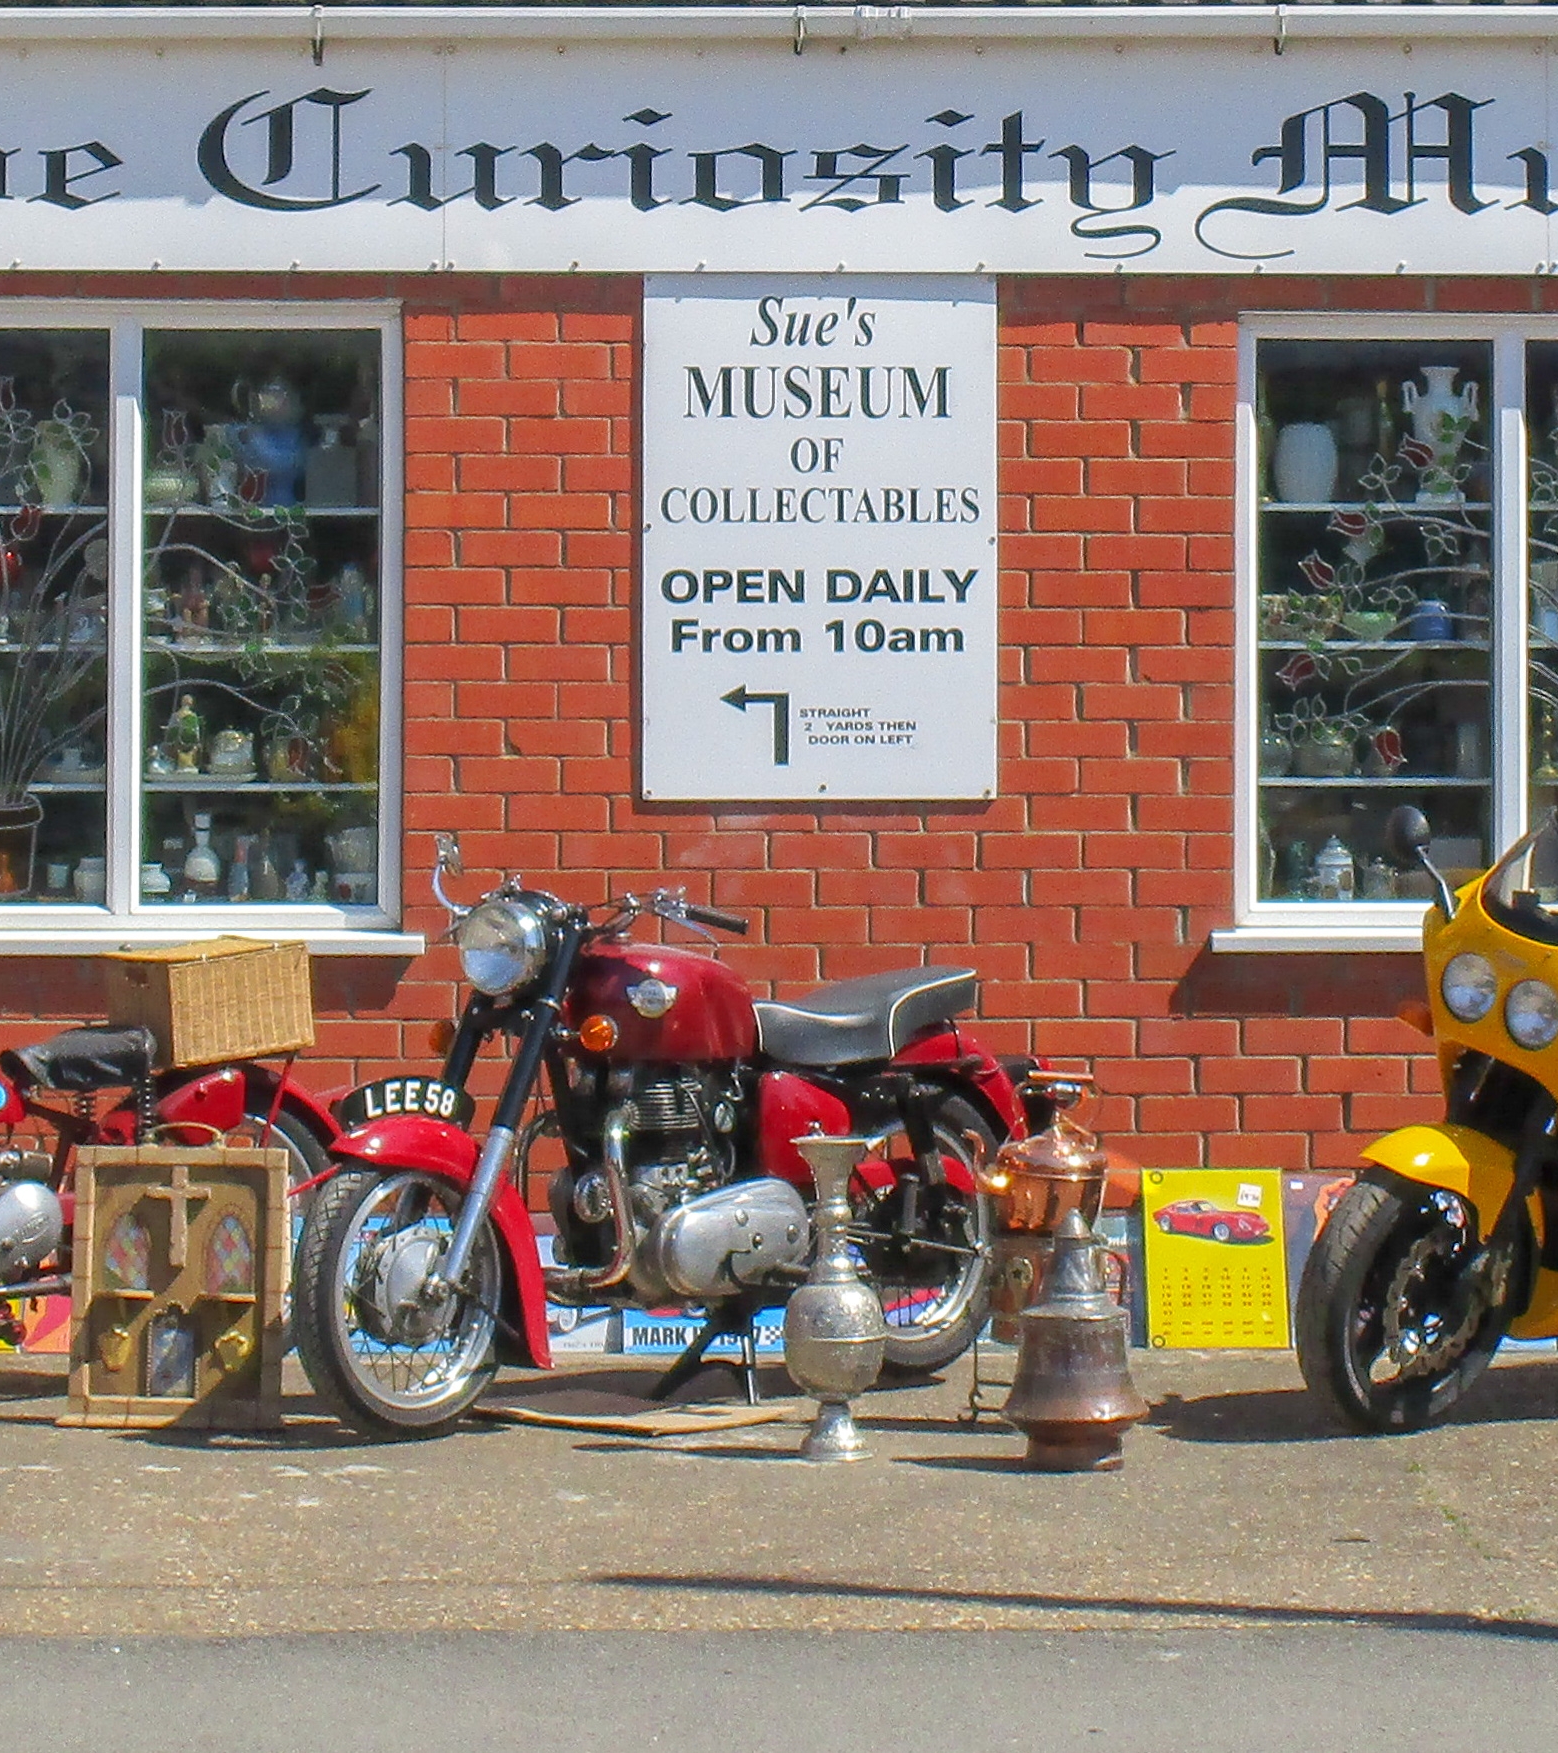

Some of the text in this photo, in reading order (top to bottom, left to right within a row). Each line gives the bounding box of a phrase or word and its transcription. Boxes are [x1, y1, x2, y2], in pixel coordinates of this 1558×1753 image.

[196, 87, 1177, 259] Curiosity
[749, 296, 877, 347] Sue's
[683, 365, 953, 420] MUSEUM
[790, 437, 844, 474] OF
[660, 487, 981, 524] COLLECTABLES
[660, 568, 979, 604] OPEN DAILY
[671, 619, 965, 653] From 10am
[799, 708, 871, 719] STRAIGHT
[804, 721, 917, 732] 2 YARDS THEN
[808, 735, 913, 746] DOOR ON LEFT
[632, 1326, 688, 1346] MARK
